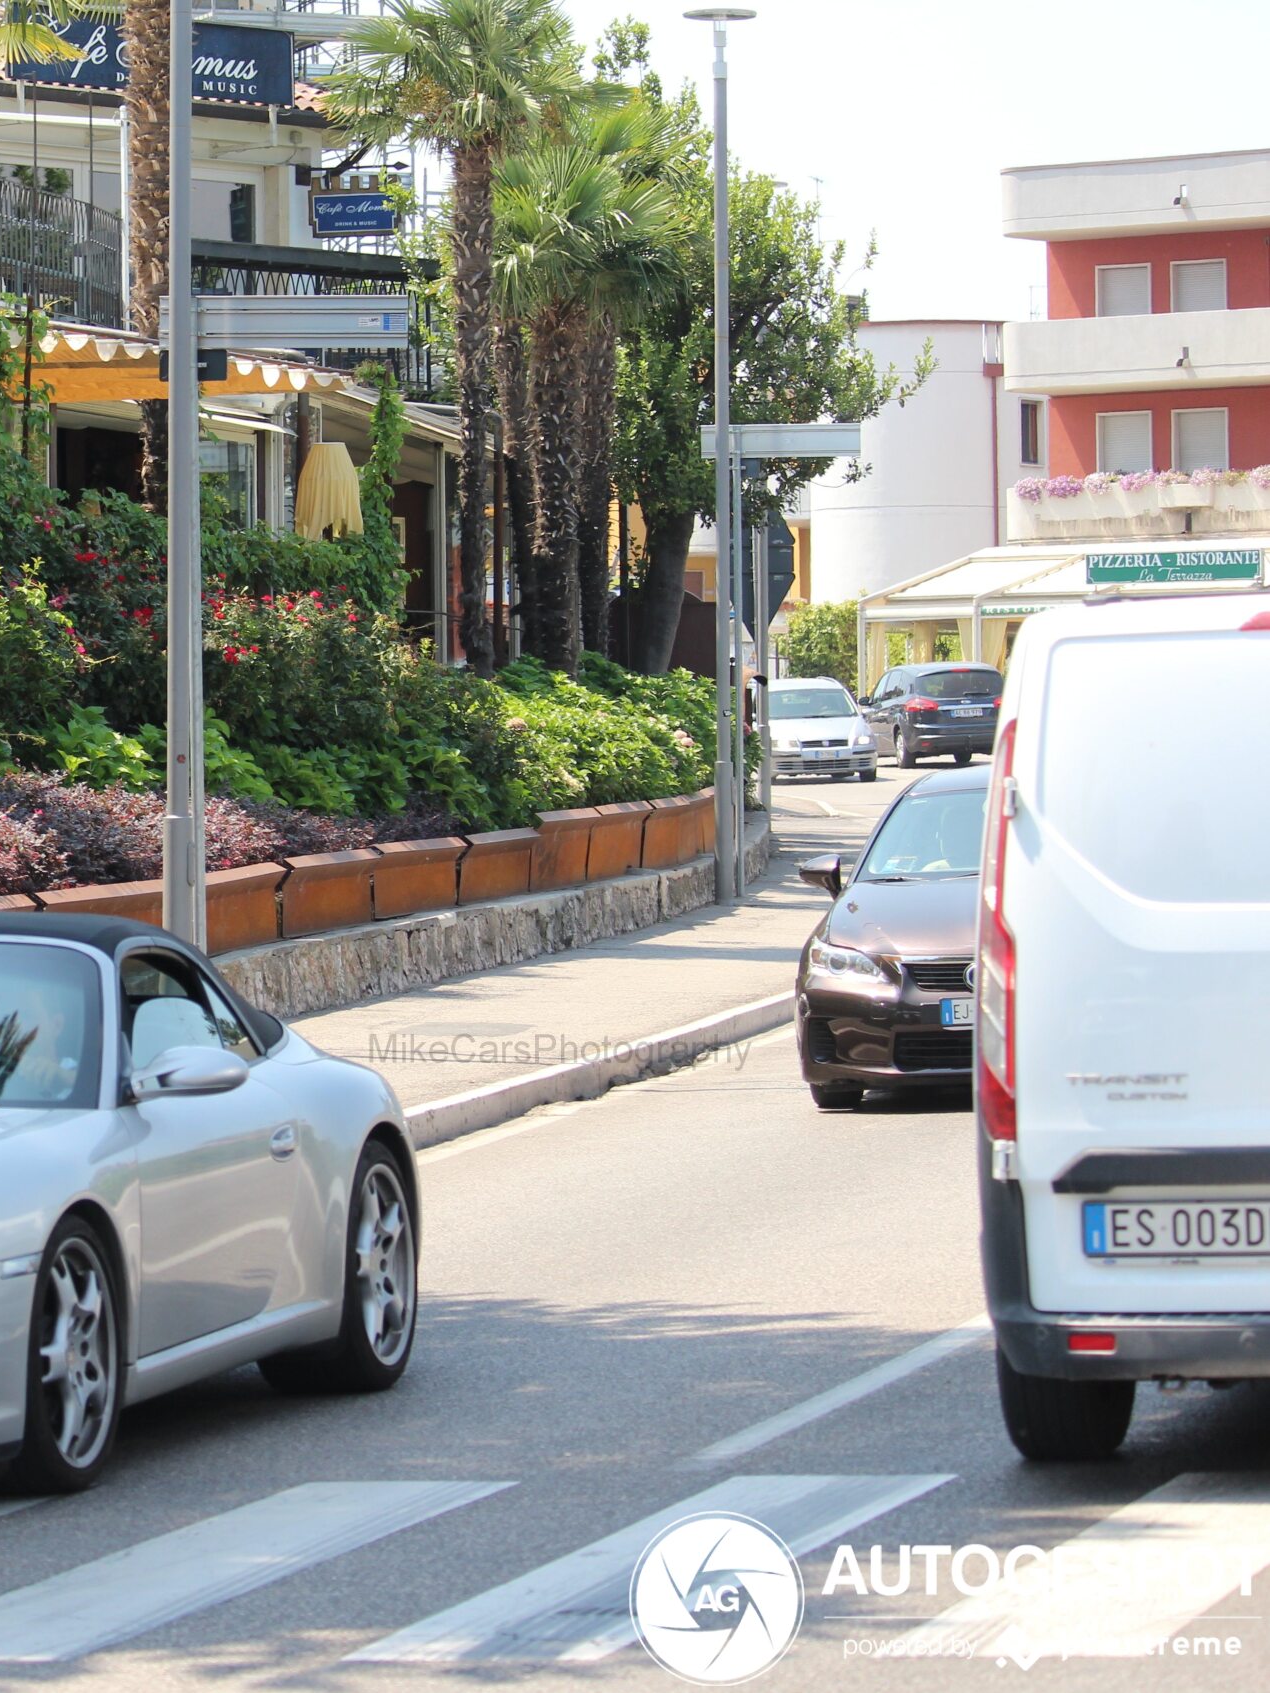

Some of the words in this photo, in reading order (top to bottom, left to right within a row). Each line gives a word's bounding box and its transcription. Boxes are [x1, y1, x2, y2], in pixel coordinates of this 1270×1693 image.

[202, 80, 258, 95] MUSIC
[1088, 553, 1162, 569] PIZZERIA
[1176, 551, 1260, 566] RISTORANTE
[1137, 568, 1154, 582] La
[1158, 567, 1213, 581] Terrazza
[1066, 1073, 1188, 1086] TRANSIT
[1107, 1092, 1187, 1101] CUSTOM
[1111, 1209, 1155, 1247] ES
[1172, 1208, 1270, 1247] 003D
